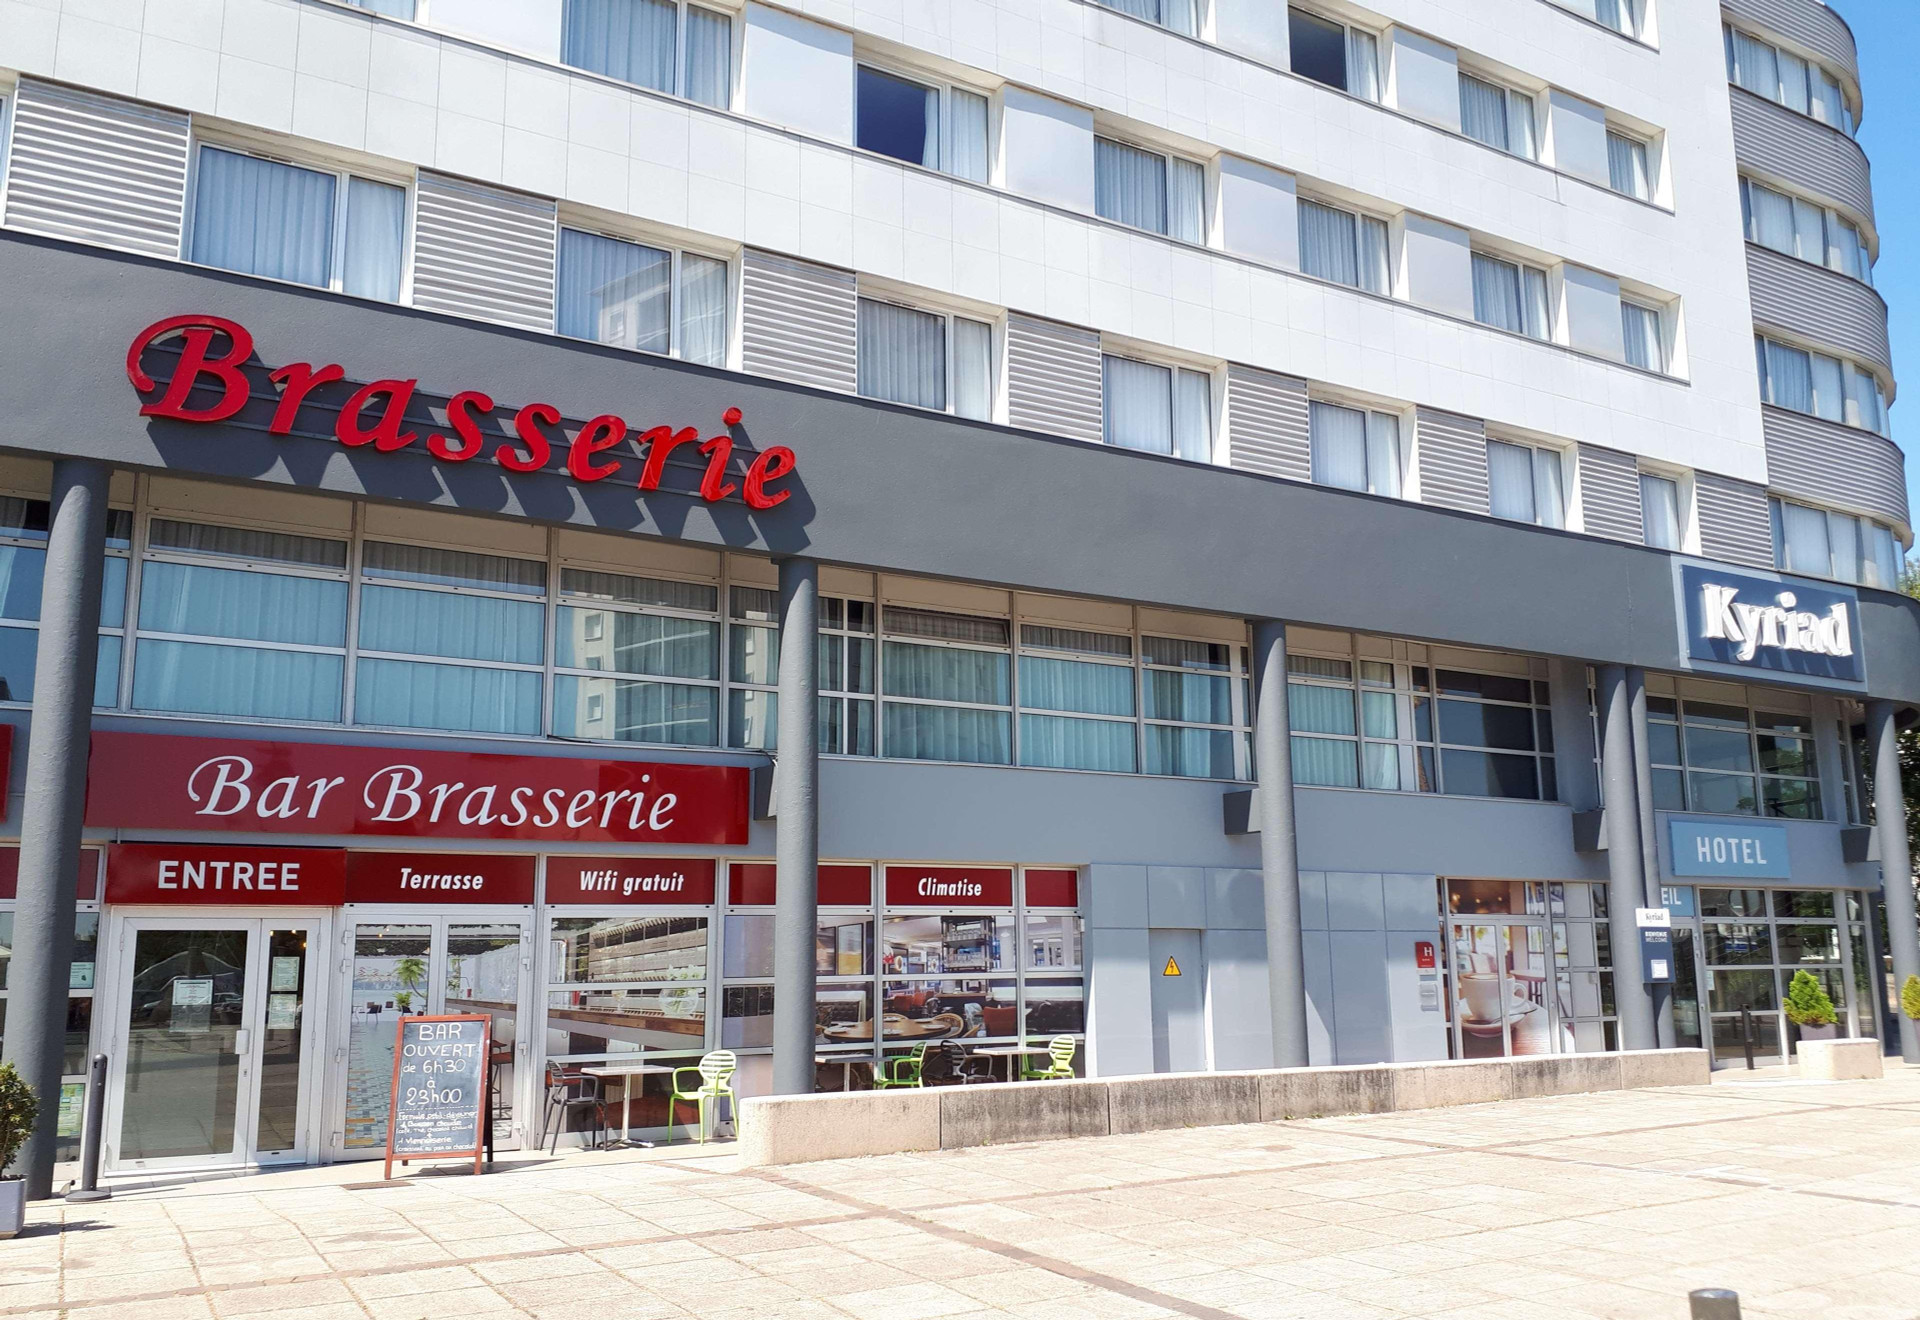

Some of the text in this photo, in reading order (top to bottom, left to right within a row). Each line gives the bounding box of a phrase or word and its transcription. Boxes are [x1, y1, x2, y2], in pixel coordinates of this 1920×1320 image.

[127, 317, 796, 509] Brasserie
[1700, 583, 1853, 661] Kyriad
[187, 756, 677, 831] Bar Brasserie
[1696, 837, 1767, 864] HOTEL
[158, 861, 300, 891] ENTREE
[400, 867, 484, 890] Terrasse
[580, 870, 684, 896] Wifi gratuit
[918, 877, 982, 897] Climatise
[1423, 946, 1433, 957] H
[419, 1022, 462, 1040] BAR
[403, 1043, 476, 1057] OUVERT
[402, 1058, 466, 1073] de 6h30
[426, 1075, 436, 1088] à
[405, 1087, 462, 1105] 23h00
